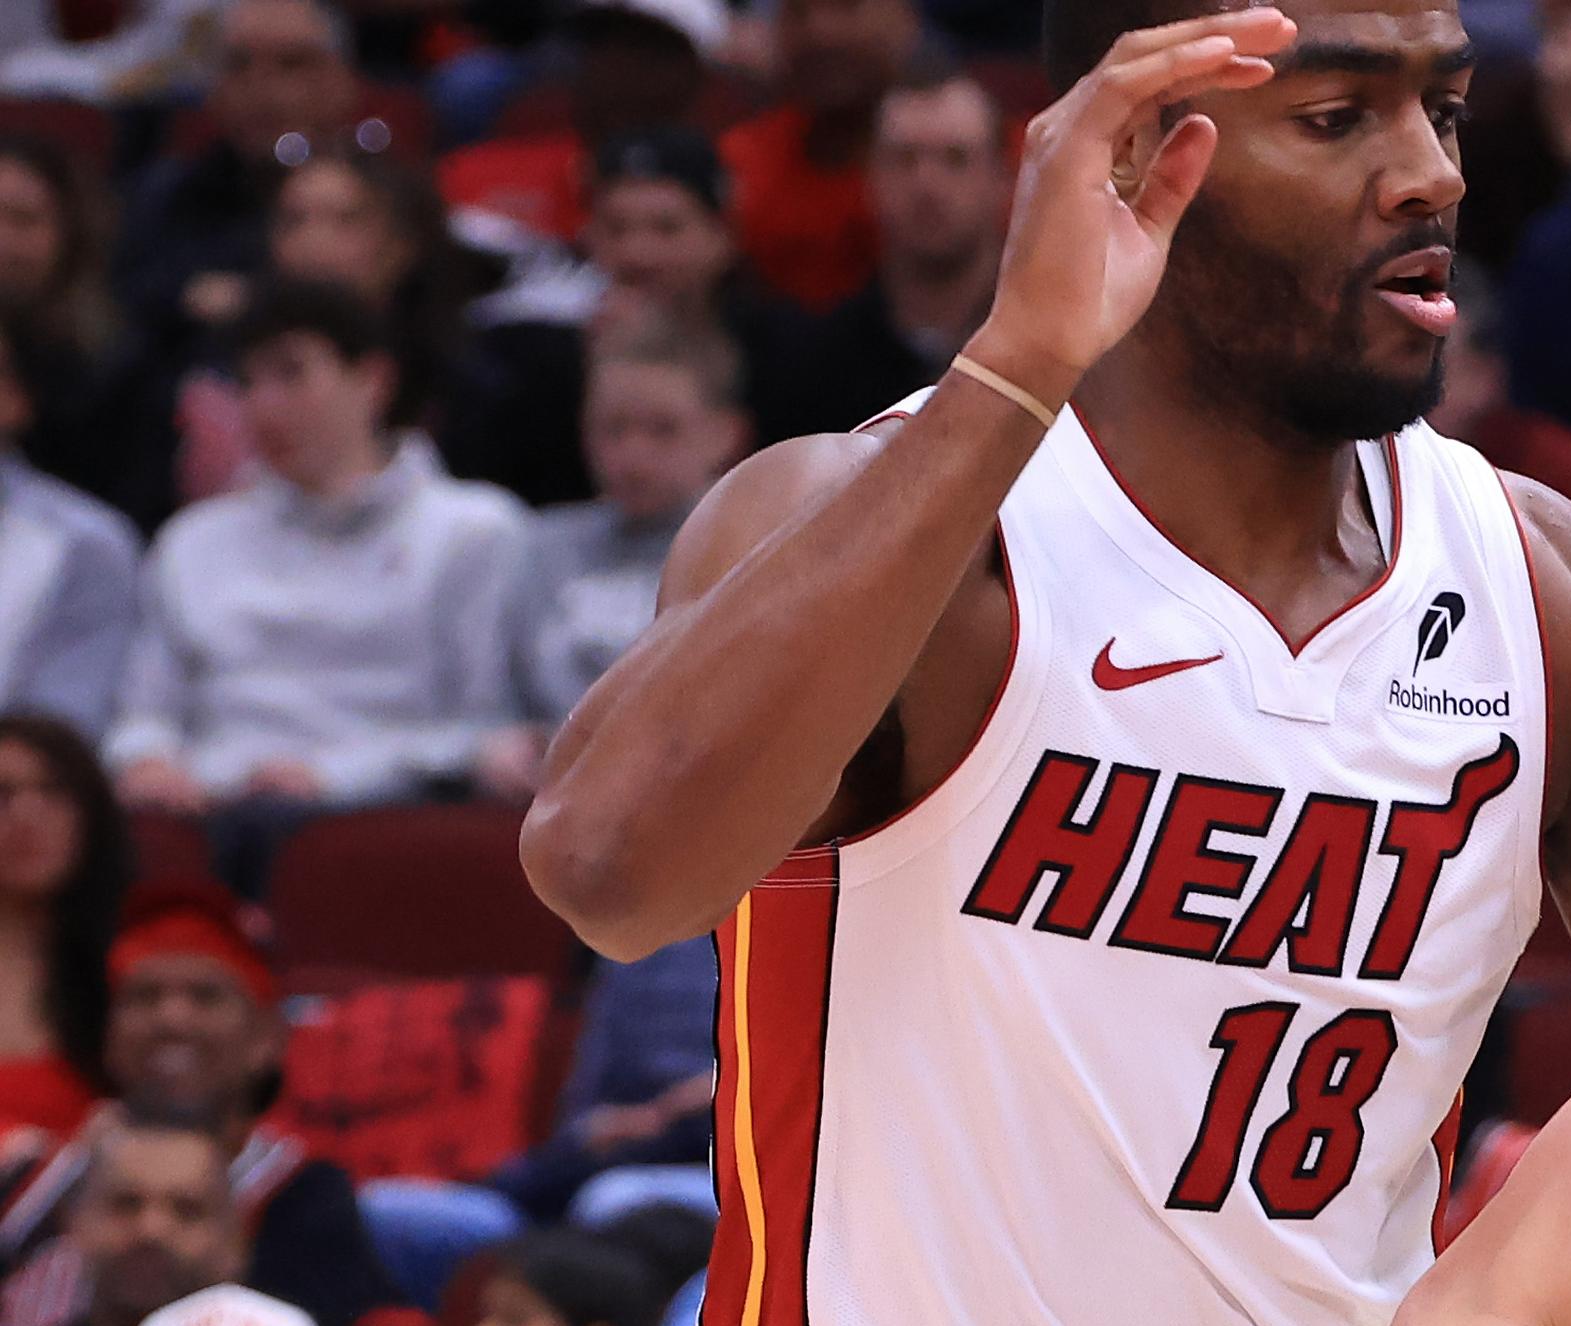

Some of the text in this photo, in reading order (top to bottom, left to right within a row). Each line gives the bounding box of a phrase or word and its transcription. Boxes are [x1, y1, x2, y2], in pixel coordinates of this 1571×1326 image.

[1389, 679, 1510, 717] Robinhood
[959, 732, 1520, 981] HEAT
[1163, 999, 1399, 1221] 18
